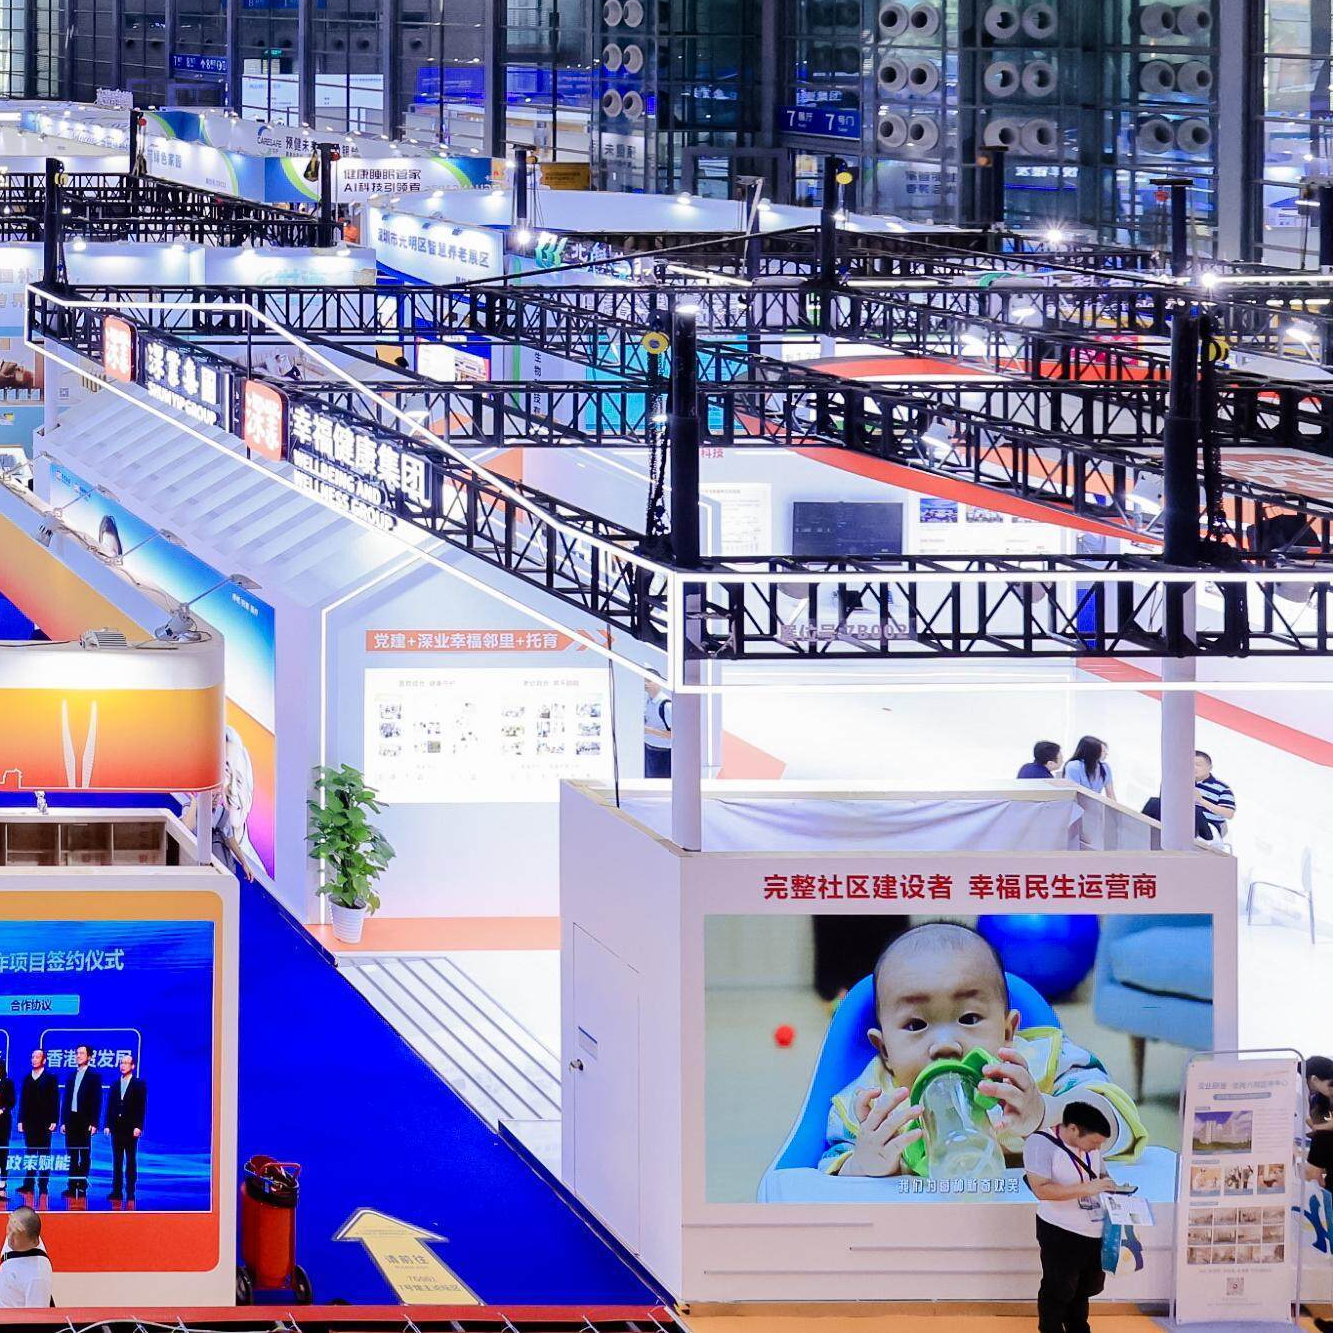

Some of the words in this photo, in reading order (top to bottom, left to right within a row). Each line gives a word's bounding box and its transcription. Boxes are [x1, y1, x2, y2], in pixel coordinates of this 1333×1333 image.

[786, 110, 795, 126] 7
[825, 113, 836, 131] 7
[344, 169, 422, 180] 健康睡眠管家
[344, 182, 421, 192] AI科技引领者
[377, 227, 490, 268] 深圳市光明区智慧养老展区
[292, 406, 433, 510] 幸福健康集团
[293, 449, 357, 494] WELLBEING
[356, 480, 383, 506] AND
[293, 469, 353, 515] WELLNESS
[352, 501, 397, 532] GROUP
[374, 632, 558, 649] 党建+深业幸福邻里+托育
[764, 874, 953, 900] 完整社区建设者
[968, 873, 1157, 900] 幸福民生运营商
[10, 999, 53, 1012] 合作协议
[5, 1154, 71, 1171] 政策赋能
